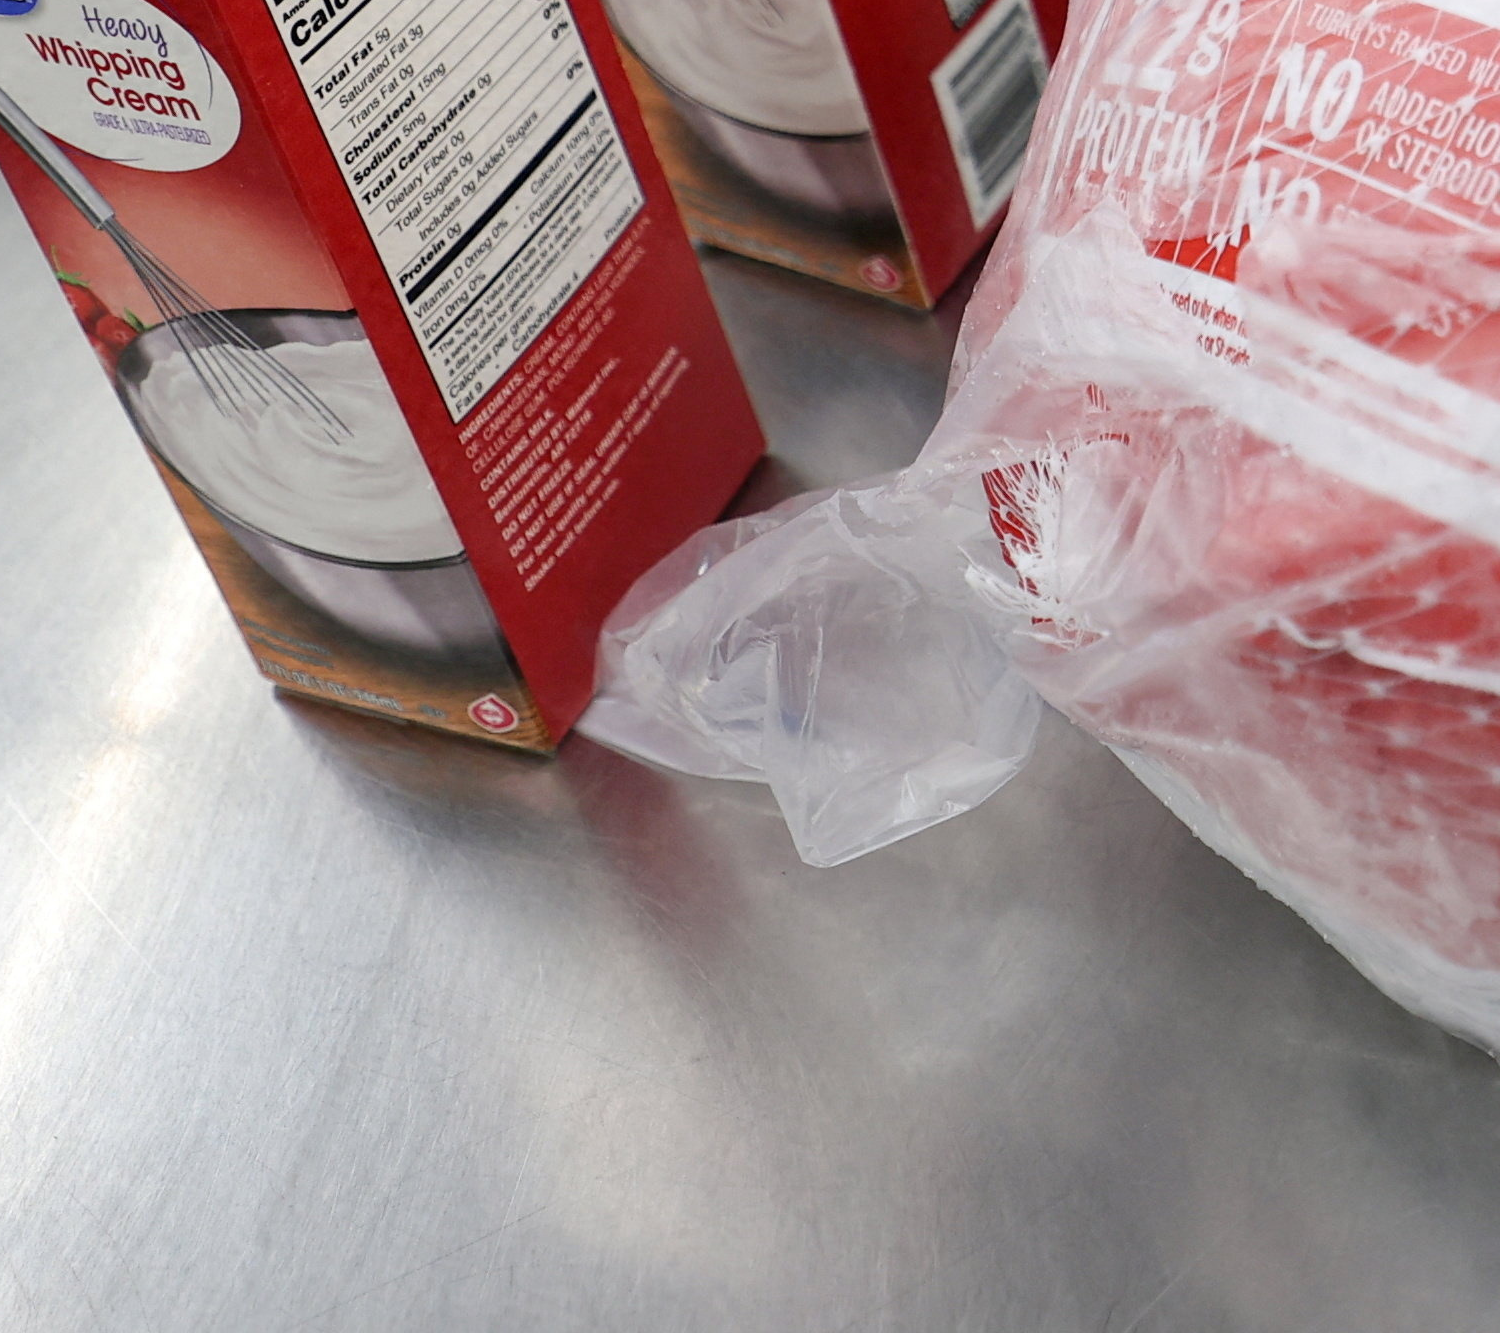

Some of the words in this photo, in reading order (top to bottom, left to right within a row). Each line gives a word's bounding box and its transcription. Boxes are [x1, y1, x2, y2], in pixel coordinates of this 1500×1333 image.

[25, 33, 185, 90] Whipping
[82, 5, 168, 58] Heavy
[314, 62, 350, 100] Total
[351, 41, 374, 67] Fat
[375, 27, 391, 45] 5g
[339, 54, 390, 109] Saturated
[389, 37, 409, 60] Fat
[408, 24, 424, 42] 3g
[1306, 2, 1388, 50] TURKEYS
[1391, 30, 1468, 76] RAISED
[86, 77, 200, 121] Cream
[93, 111, 119, 130] GRADE
[344, 90, 416, 165] Cholesterol
[417, 62, 446, 92] 15mg
[347, 97, 380, 129] Trans
[379, 77, 399, 100] Fat
[398, 64, 415, 81] 0g
[361, 168, 397, 205] Total
[398, 89, 476, 171] Carbohydrate
[477, 73, 492, 90] 0g
[543, 1, 561, 20] 0%
[385, 173, 423, 214] Dietary
[423, 145, 449, 175] Fiber
[450, 130, 466, 148] 0g
[551, 21, 569, 40] 0%
[1264, 42, 1365, 143] NO
[1368, 80, 1462, 140] ADDED
[353, 136, 402, 186] Sodium
[402, 111, 427, 138] 5mg
[418, 195, 461, 241] Includes
[461, 180, 477, 197] 0g
[476, 144, 506, 183] Added
[505, 111, 538, 149] Sugars
[1065, 88, 1219, 189] PROTEIN
[394, 201, 423, 232] Total
[422, 166, 459, 206] Sugars
[458, 151, 474, 168] 0g
[399, 239, 446, 288] Protein
[446, 222, 462, 240] 0g
[413, 278, 454, 319] Vitamin
[453, 265, 464, 280] D
[464, 236, 493, 269] 0mcg
[491, 220, 509, 239] 0%
[530, 153, 566, 195] Calcium
[422, 315, 446, 340] Iron
[444, 290, 470, 317] 0mg
[468, 273, 487, 292] 0%
[528, 172, 573, 224] Potassium
[455, 390, 475, 414] Fat
[474, 381, 483, 394] 9
[512, 282, 572, 352] Carbohydrate
[572, 272, 579, 281] 4
[604, 206, 632, 241] Protein
[449, 352, 492, 399] Calories
[492, 333, 508, 357] per
[509, 305, 534, 338] gram:
[480, 435, 530, 491] CONTAINS
